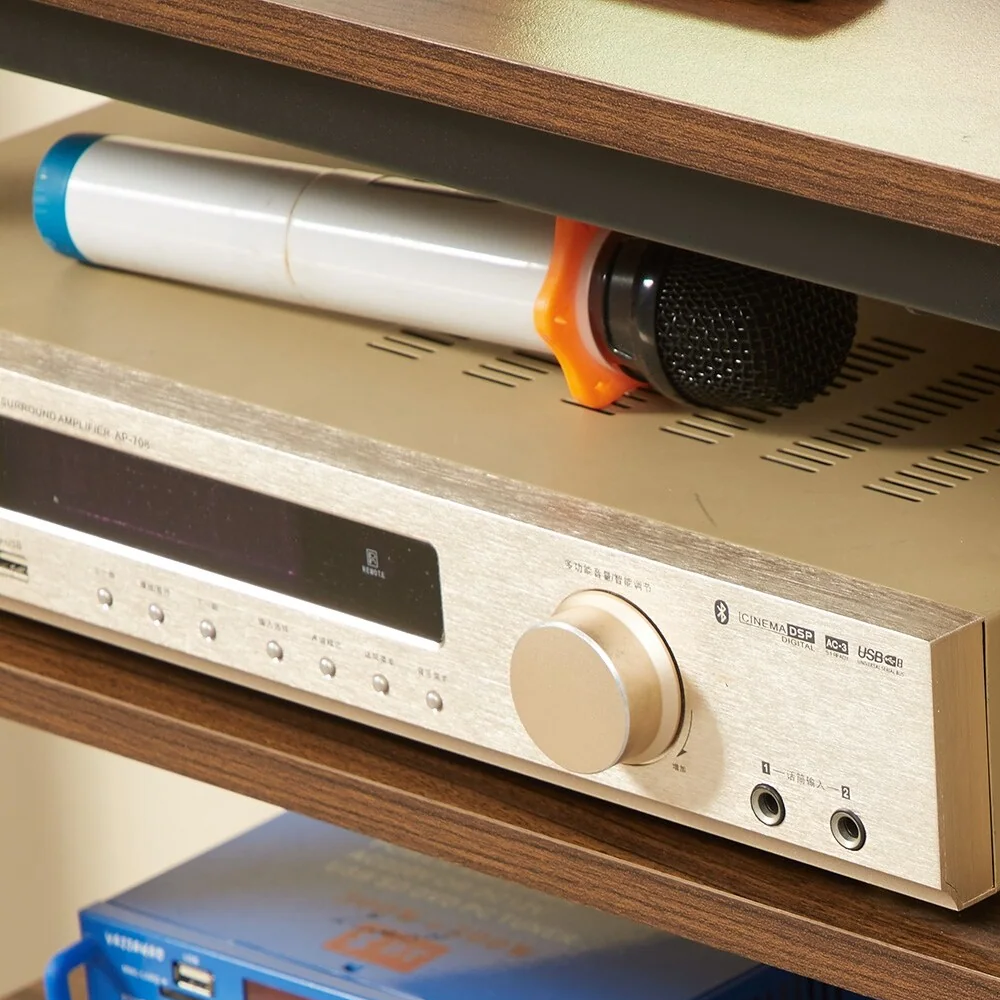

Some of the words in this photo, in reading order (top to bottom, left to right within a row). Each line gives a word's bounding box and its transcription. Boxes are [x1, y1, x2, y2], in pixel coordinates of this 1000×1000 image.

[58, 414, 111, 438] AMPLIFIER
[741, 612, 787, 634] CINEMA
[788, 624, 814, 642] DSP
[781, 635, 815, 652] DIGITAL
[857, 645, 884, 664] USB
[762, 761, 771, 775] 1
[786, 770, 826, 791] 话筒输入
[841, 785, 850, 800] 2
